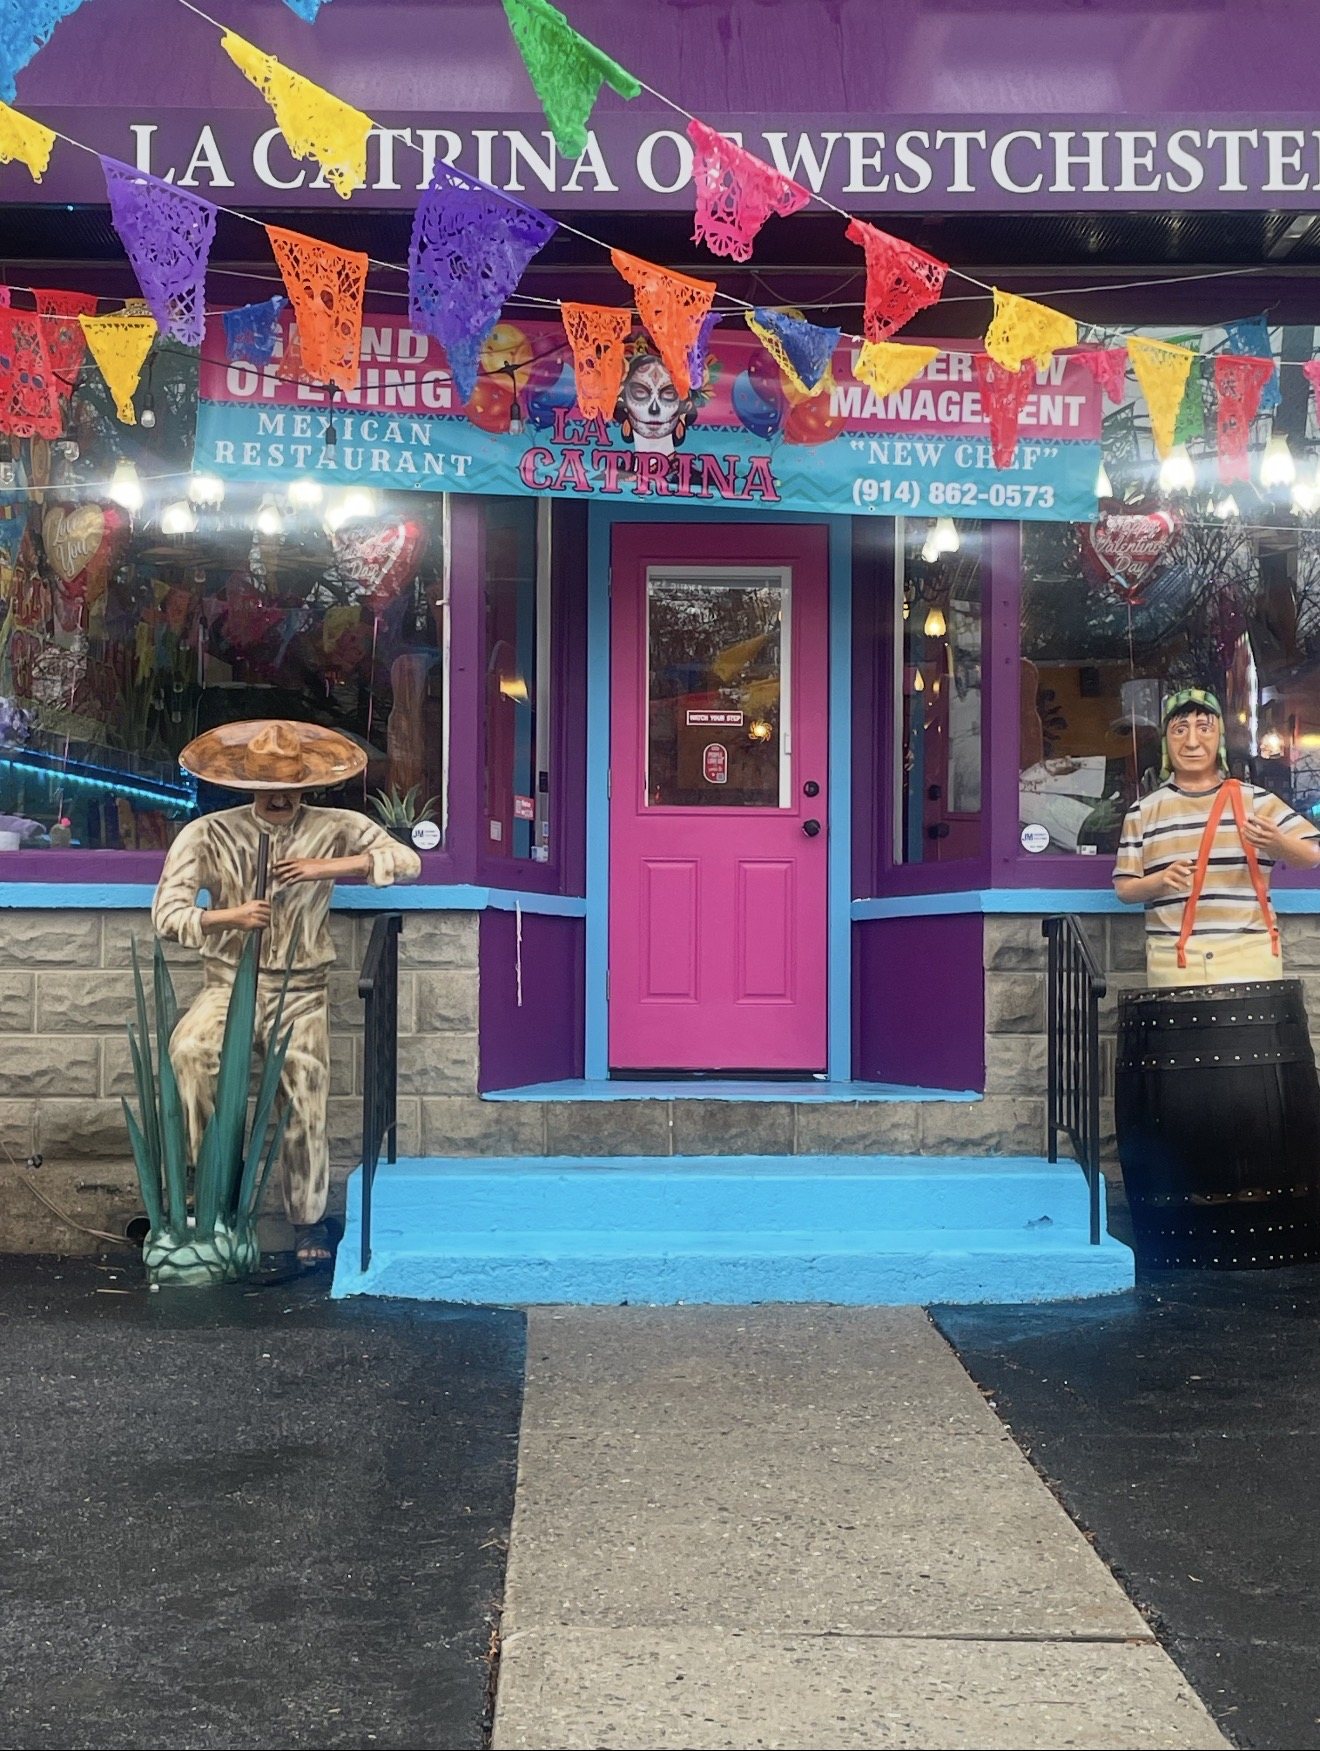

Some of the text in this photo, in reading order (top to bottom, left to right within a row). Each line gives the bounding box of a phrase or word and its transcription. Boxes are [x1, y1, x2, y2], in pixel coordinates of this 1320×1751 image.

[129, 124, 236, 187] LA
[636, 130, 743, 193] O
[761, 129, 1320, 193] WESTCHESTE
[829, 385, 1086, 427] MANAGEENT
[257, 412, 433, 446] MEXICAN
[551, 406, 613, 446] LA
[214, 440, 473, 477] RESTAURANT
[518, 447, 781, 501] CATRINA
[852, 478, 1055, 509] (914) 862-0573
[56, 538, 89, 577] You
[1115, 556, 1147, 580] Day
